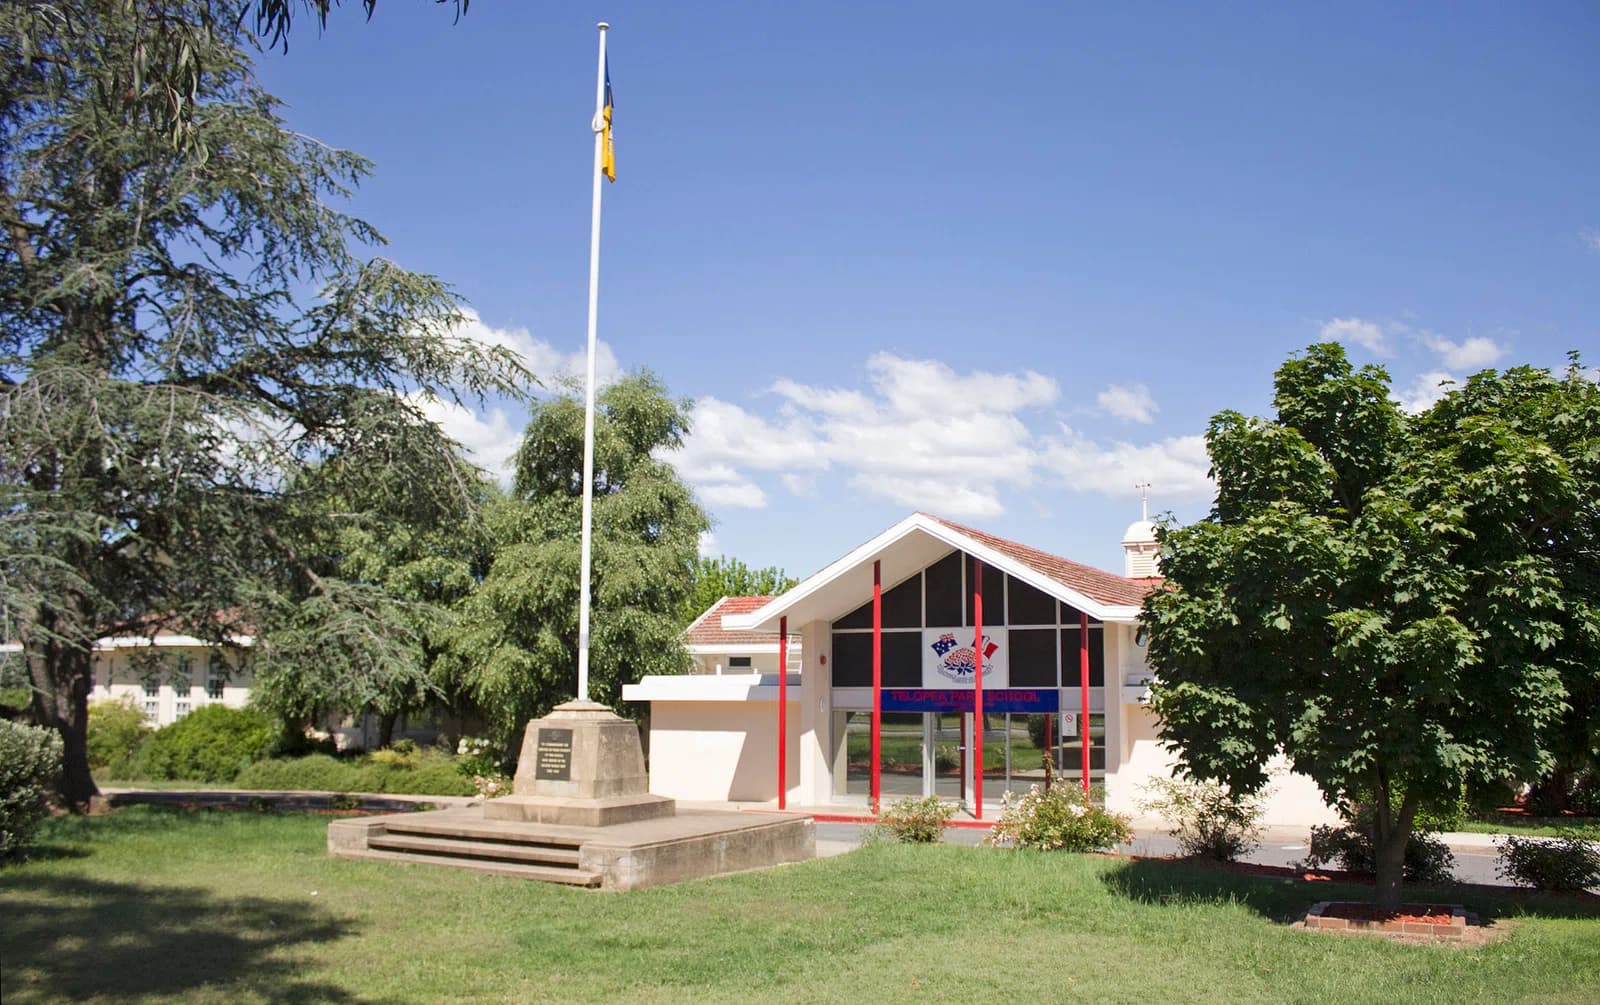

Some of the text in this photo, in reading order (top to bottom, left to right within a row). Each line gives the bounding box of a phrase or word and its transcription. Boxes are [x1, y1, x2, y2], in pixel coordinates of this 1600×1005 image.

[892, 690, 1040, 702] TELOPEA PAR SCHOOL
